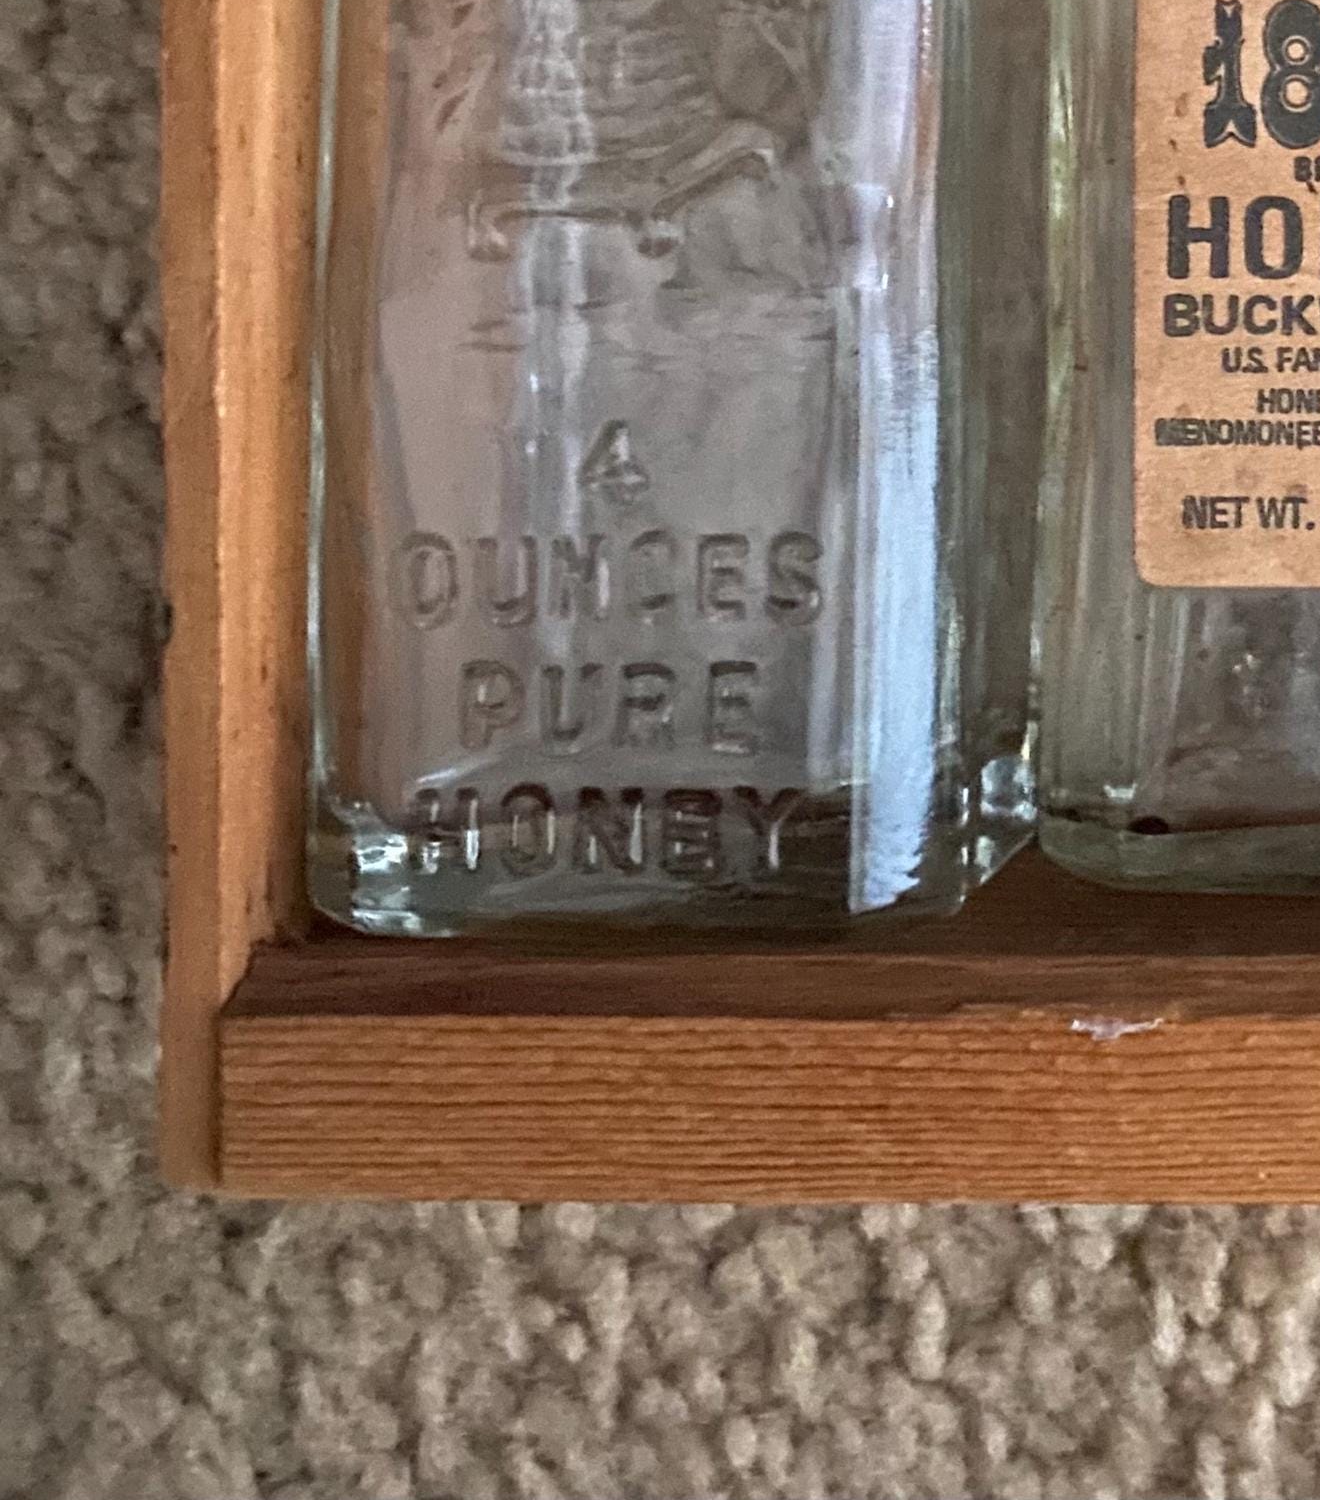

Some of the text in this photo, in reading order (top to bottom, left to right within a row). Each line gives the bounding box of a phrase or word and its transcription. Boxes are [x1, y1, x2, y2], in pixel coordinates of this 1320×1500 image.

[582, 420, 648, 502] 4
[1183, 497, 1249, 529] NET
[1256, 497, 1315, 531] WT.
[403, 530, 824, 629] OUNCES
[460, 660, 758, 756] PURE
[413, 782, 806, 876] HONEY
